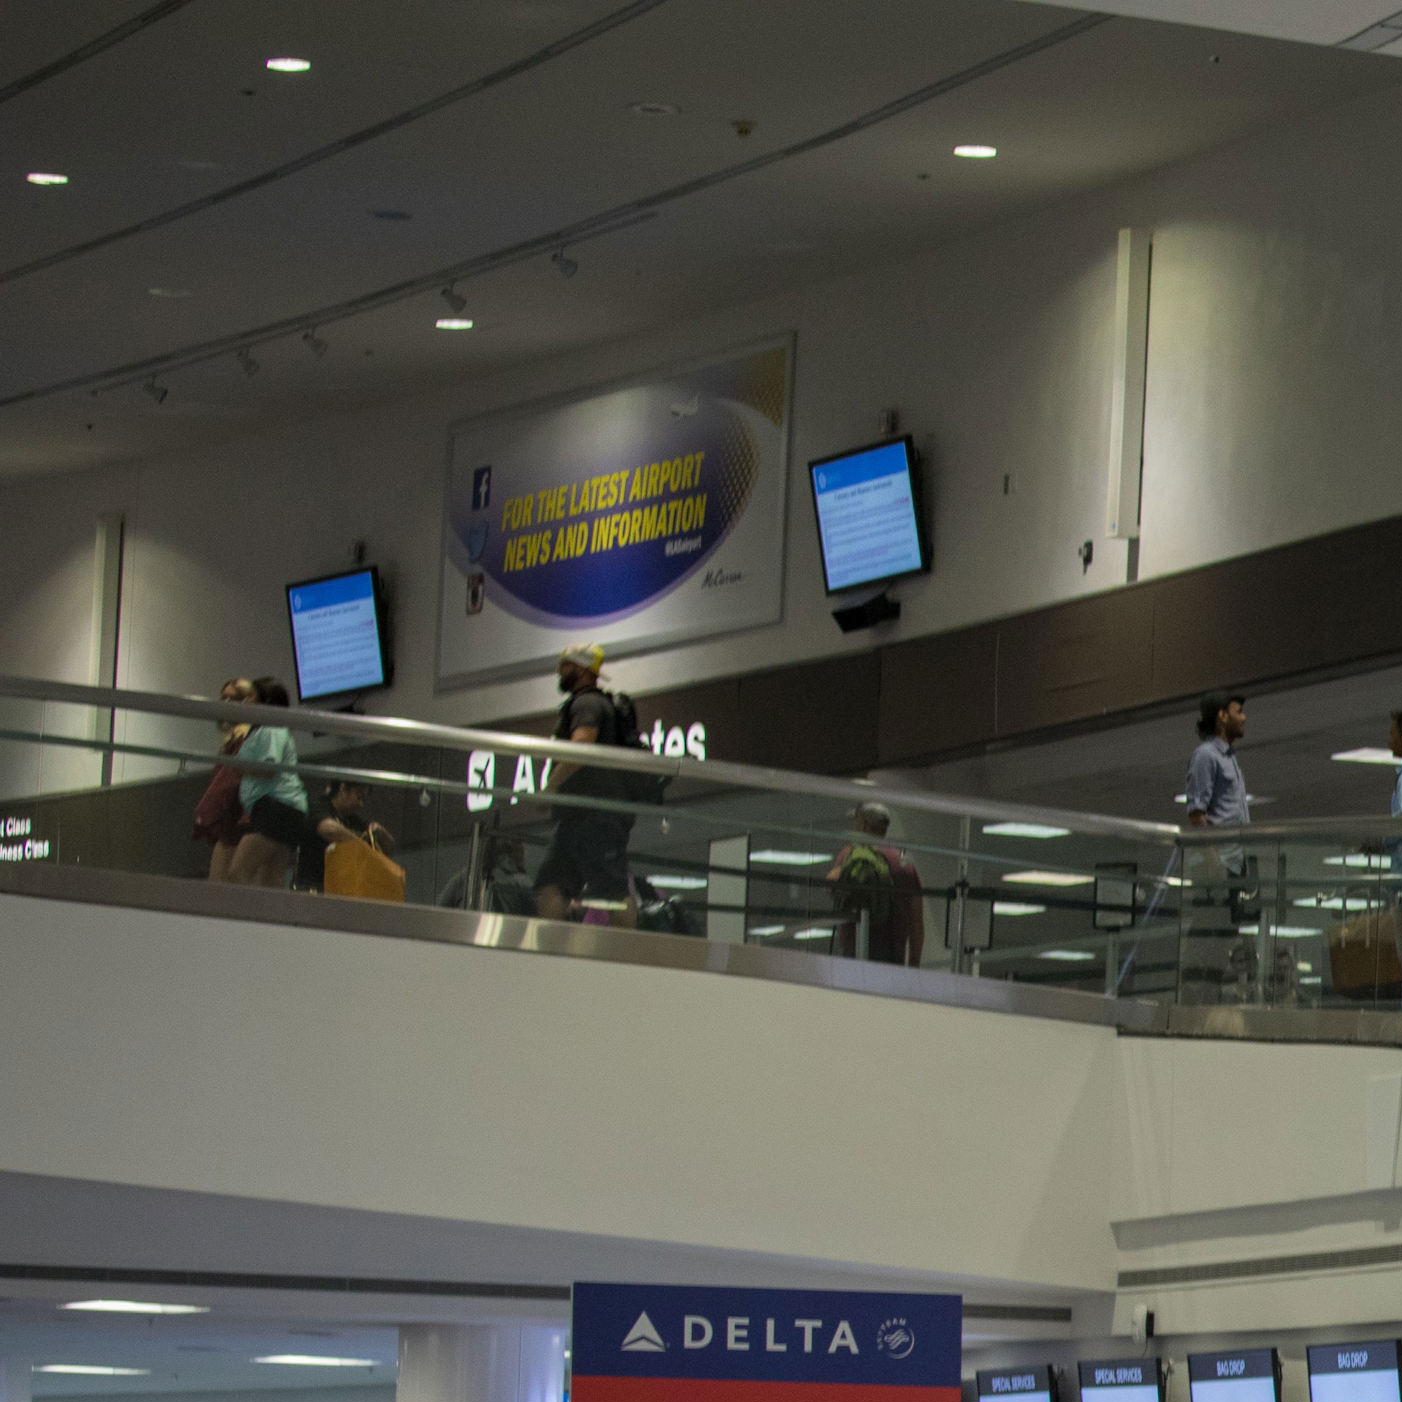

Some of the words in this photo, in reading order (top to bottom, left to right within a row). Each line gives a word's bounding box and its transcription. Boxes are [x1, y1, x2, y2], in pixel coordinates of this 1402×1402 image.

[502, 493, 534, 531] FOR
[537, 483, 569, 524] THE
[569, 470, 630, 516] LATEST
[629, 451, 705, 503] AIRPORT
[503, 529, 553, 573] NEWS
[552, 522, 589, 562] AND
[590, 493, 708, 555] INFORMATION
[683, 1314, 859, 1355] DELTA
[1337, 1352, 1350, 1369] BAG
[1350, 1351, 1368, 1368] DROP
